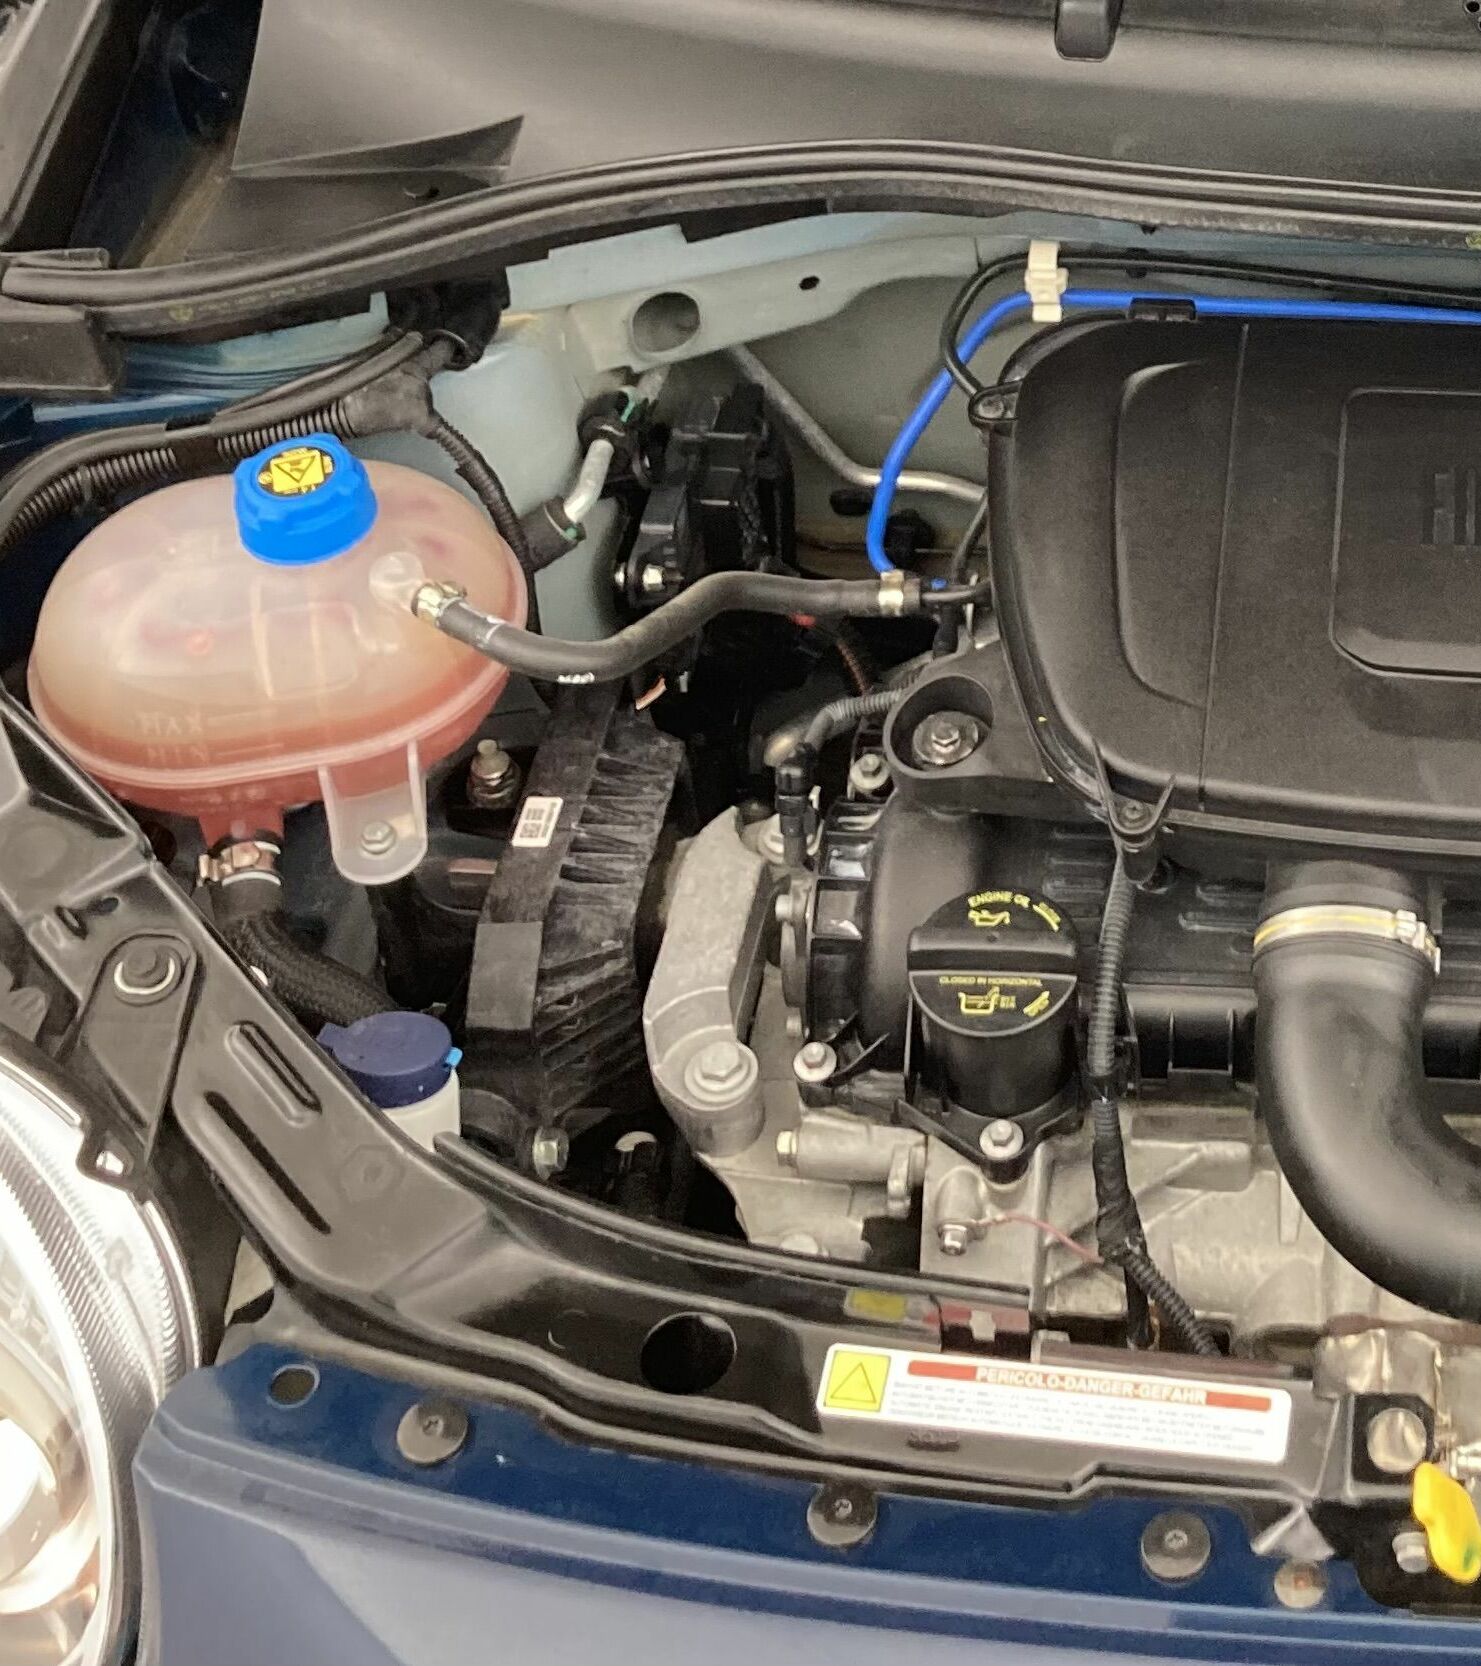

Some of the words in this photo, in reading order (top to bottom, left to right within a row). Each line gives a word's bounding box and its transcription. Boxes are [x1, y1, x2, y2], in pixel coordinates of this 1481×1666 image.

[968, 891, 1012, 908] ENGINE
[987, 977, 1043, 988] HORIZONTAL
[976, 1366, 1207, 1405] PERICOLO-DANGER-GEFAHR
